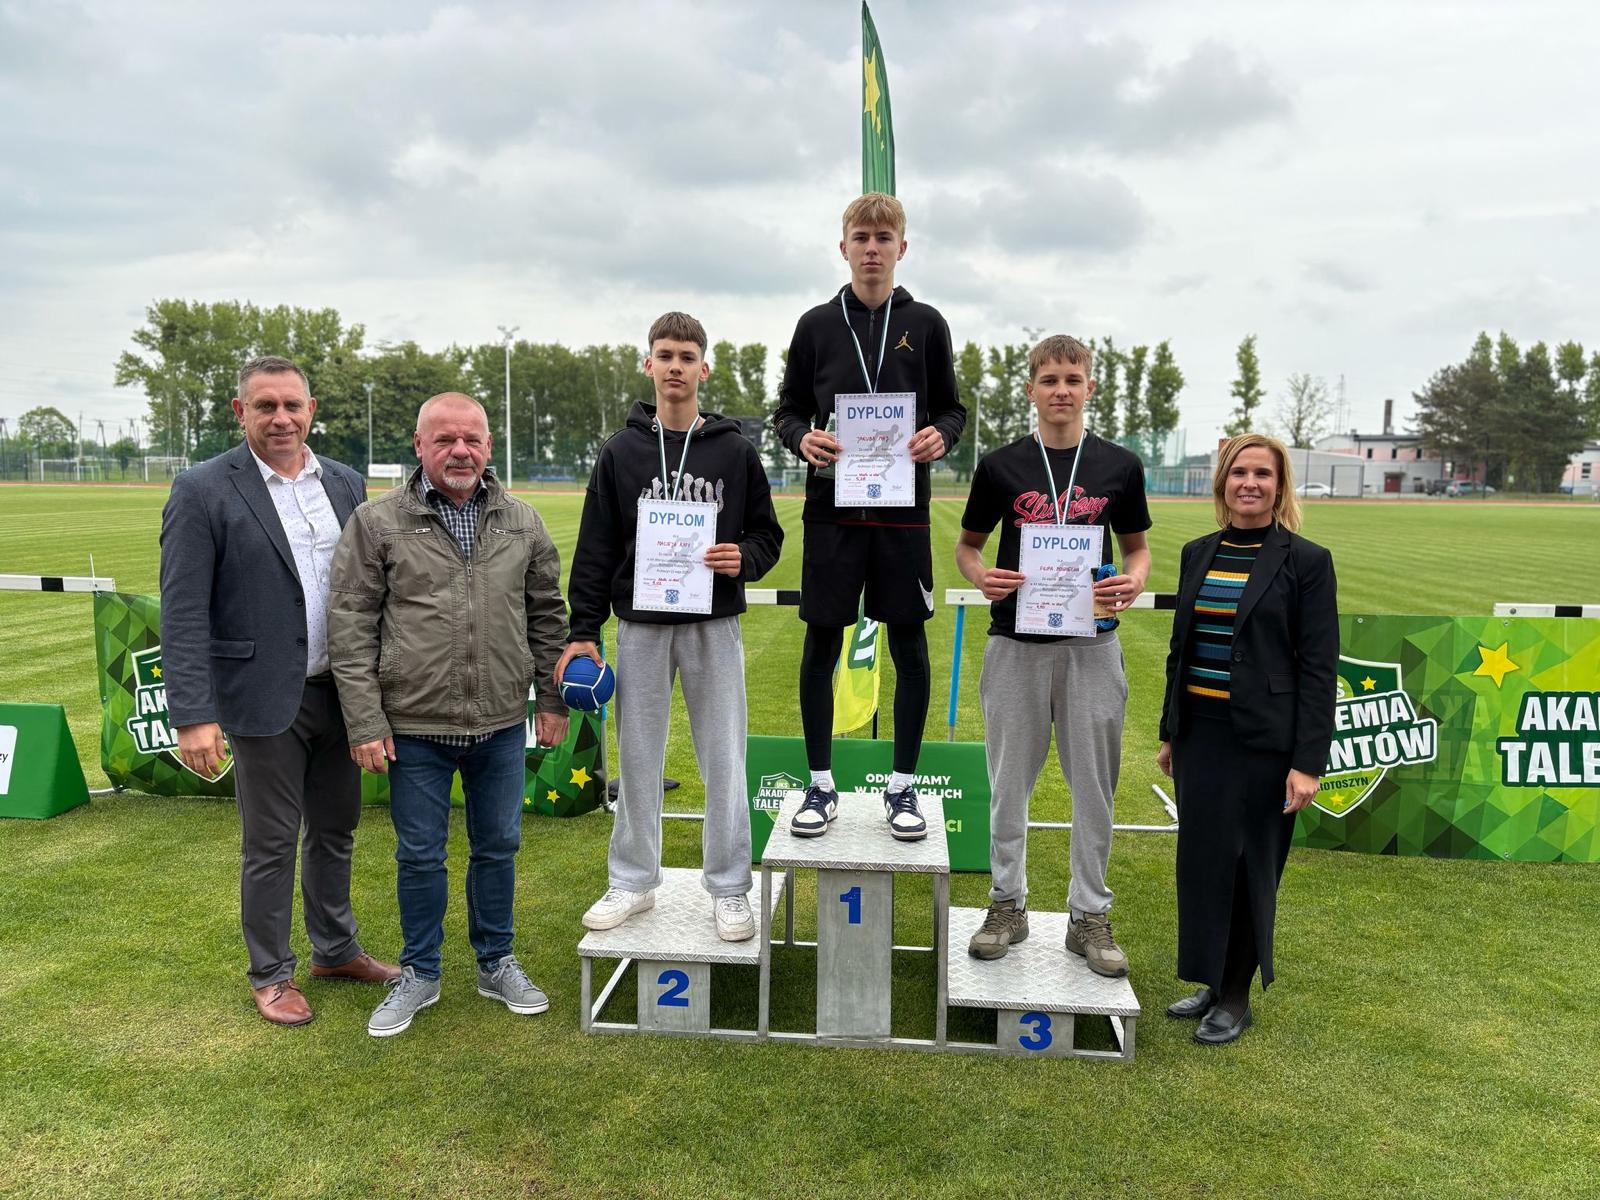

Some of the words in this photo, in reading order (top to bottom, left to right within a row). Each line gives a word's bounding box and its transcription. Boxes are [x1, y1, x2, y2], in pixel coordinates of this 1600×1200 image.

[847, 405, 904, 419] DYPLOM
[649, 511, 706, 527] DYPLOM
[1032, 536, 1091, 551] DYPLOM
[1335, 697, 1411, 732] EMIA
[1521, 696, 1600, 731] AKA
[840, 887, 862, 925] 1
[657, 969, 690, 1007] 2
[1019, 1013, 1053, 1051] 3
